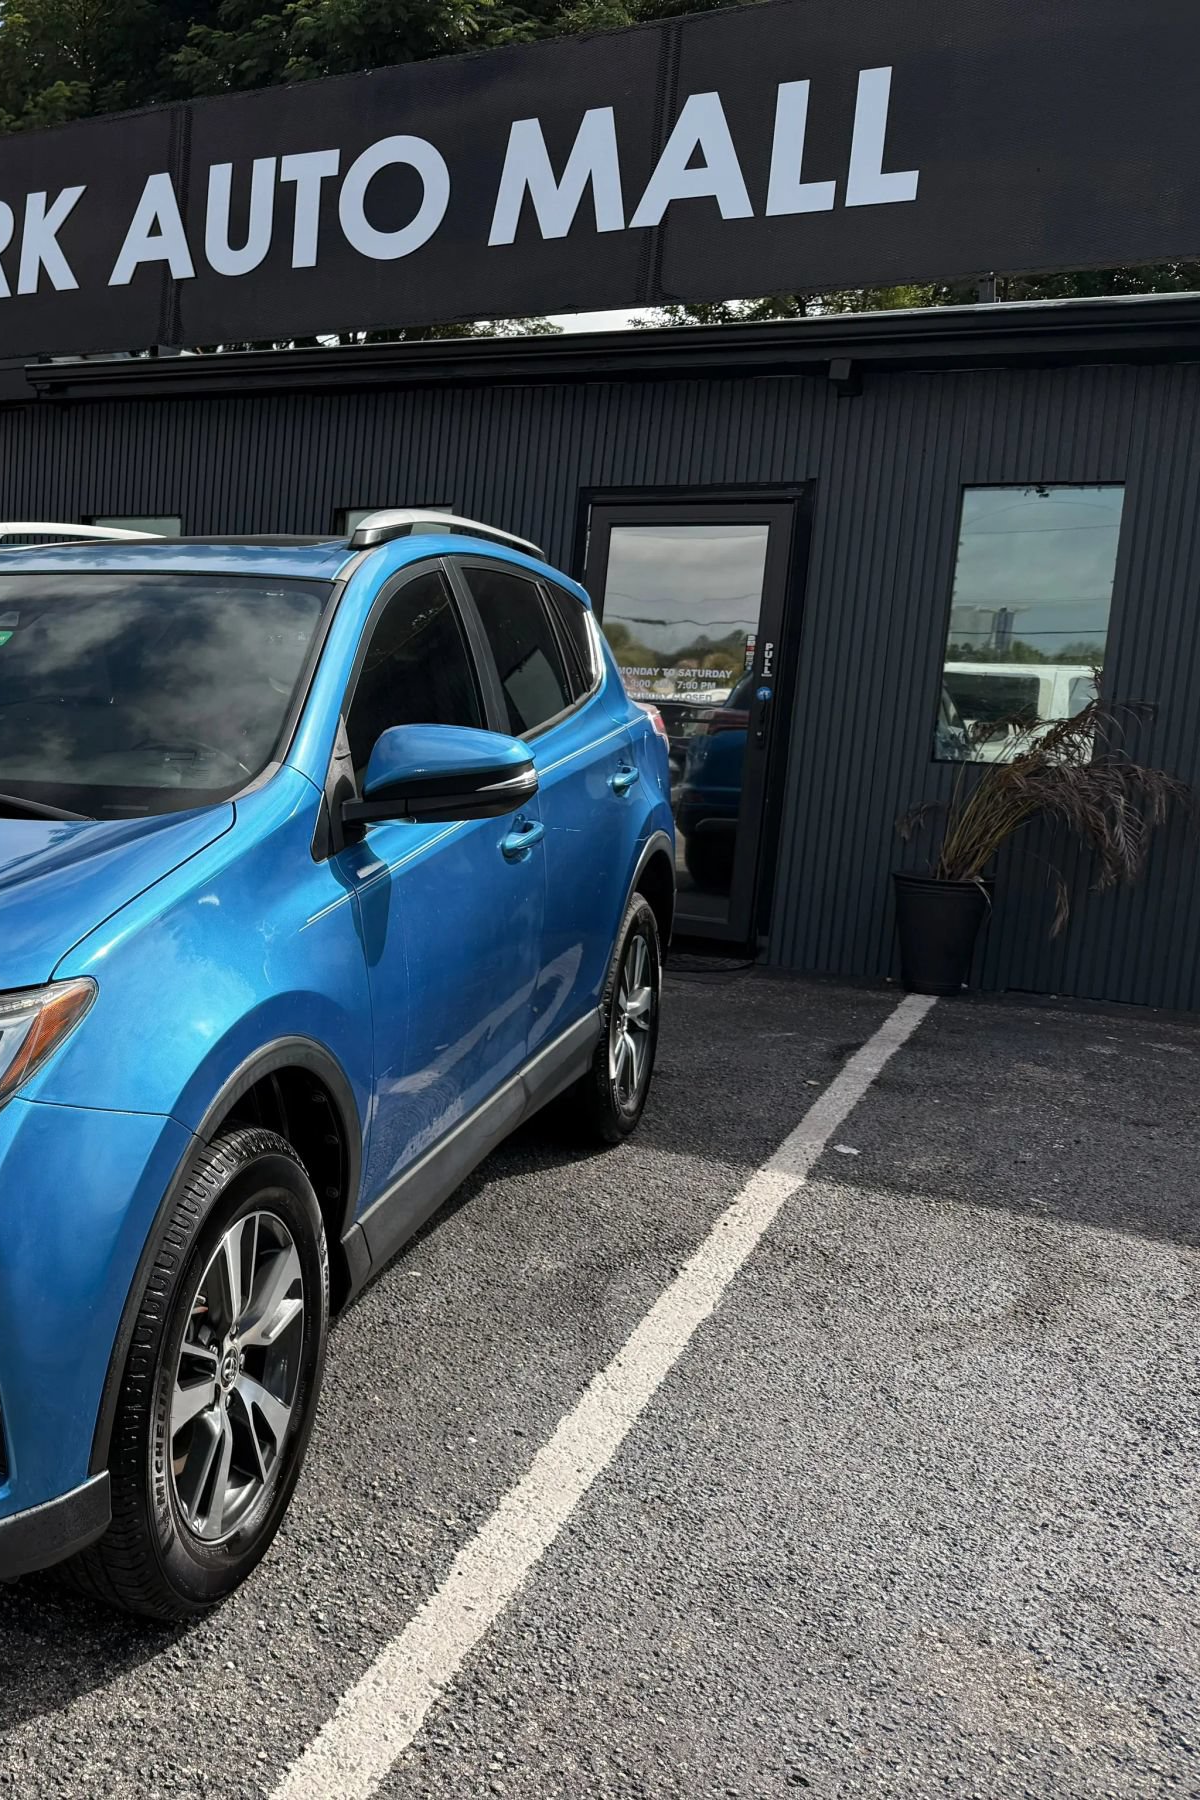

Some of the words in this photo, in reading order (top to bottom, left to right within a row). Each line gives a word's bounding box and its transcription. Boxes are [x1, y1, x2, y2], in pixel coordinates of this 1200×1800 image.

[108, 134, 452, 287] AUTO
[487, 66, 921, 247] MALL
[618, 666, 659, 676] MONDAY
[661, 668, 676, 677] TO
[678, 668, 733, 679] SATURDAY
[763, 642, 774, 674] PULL
[676, 680, 698, 690] 7:00
[700, 681, 717, 690] PM
[155, 1374, 170, 1506] MICHELIN
